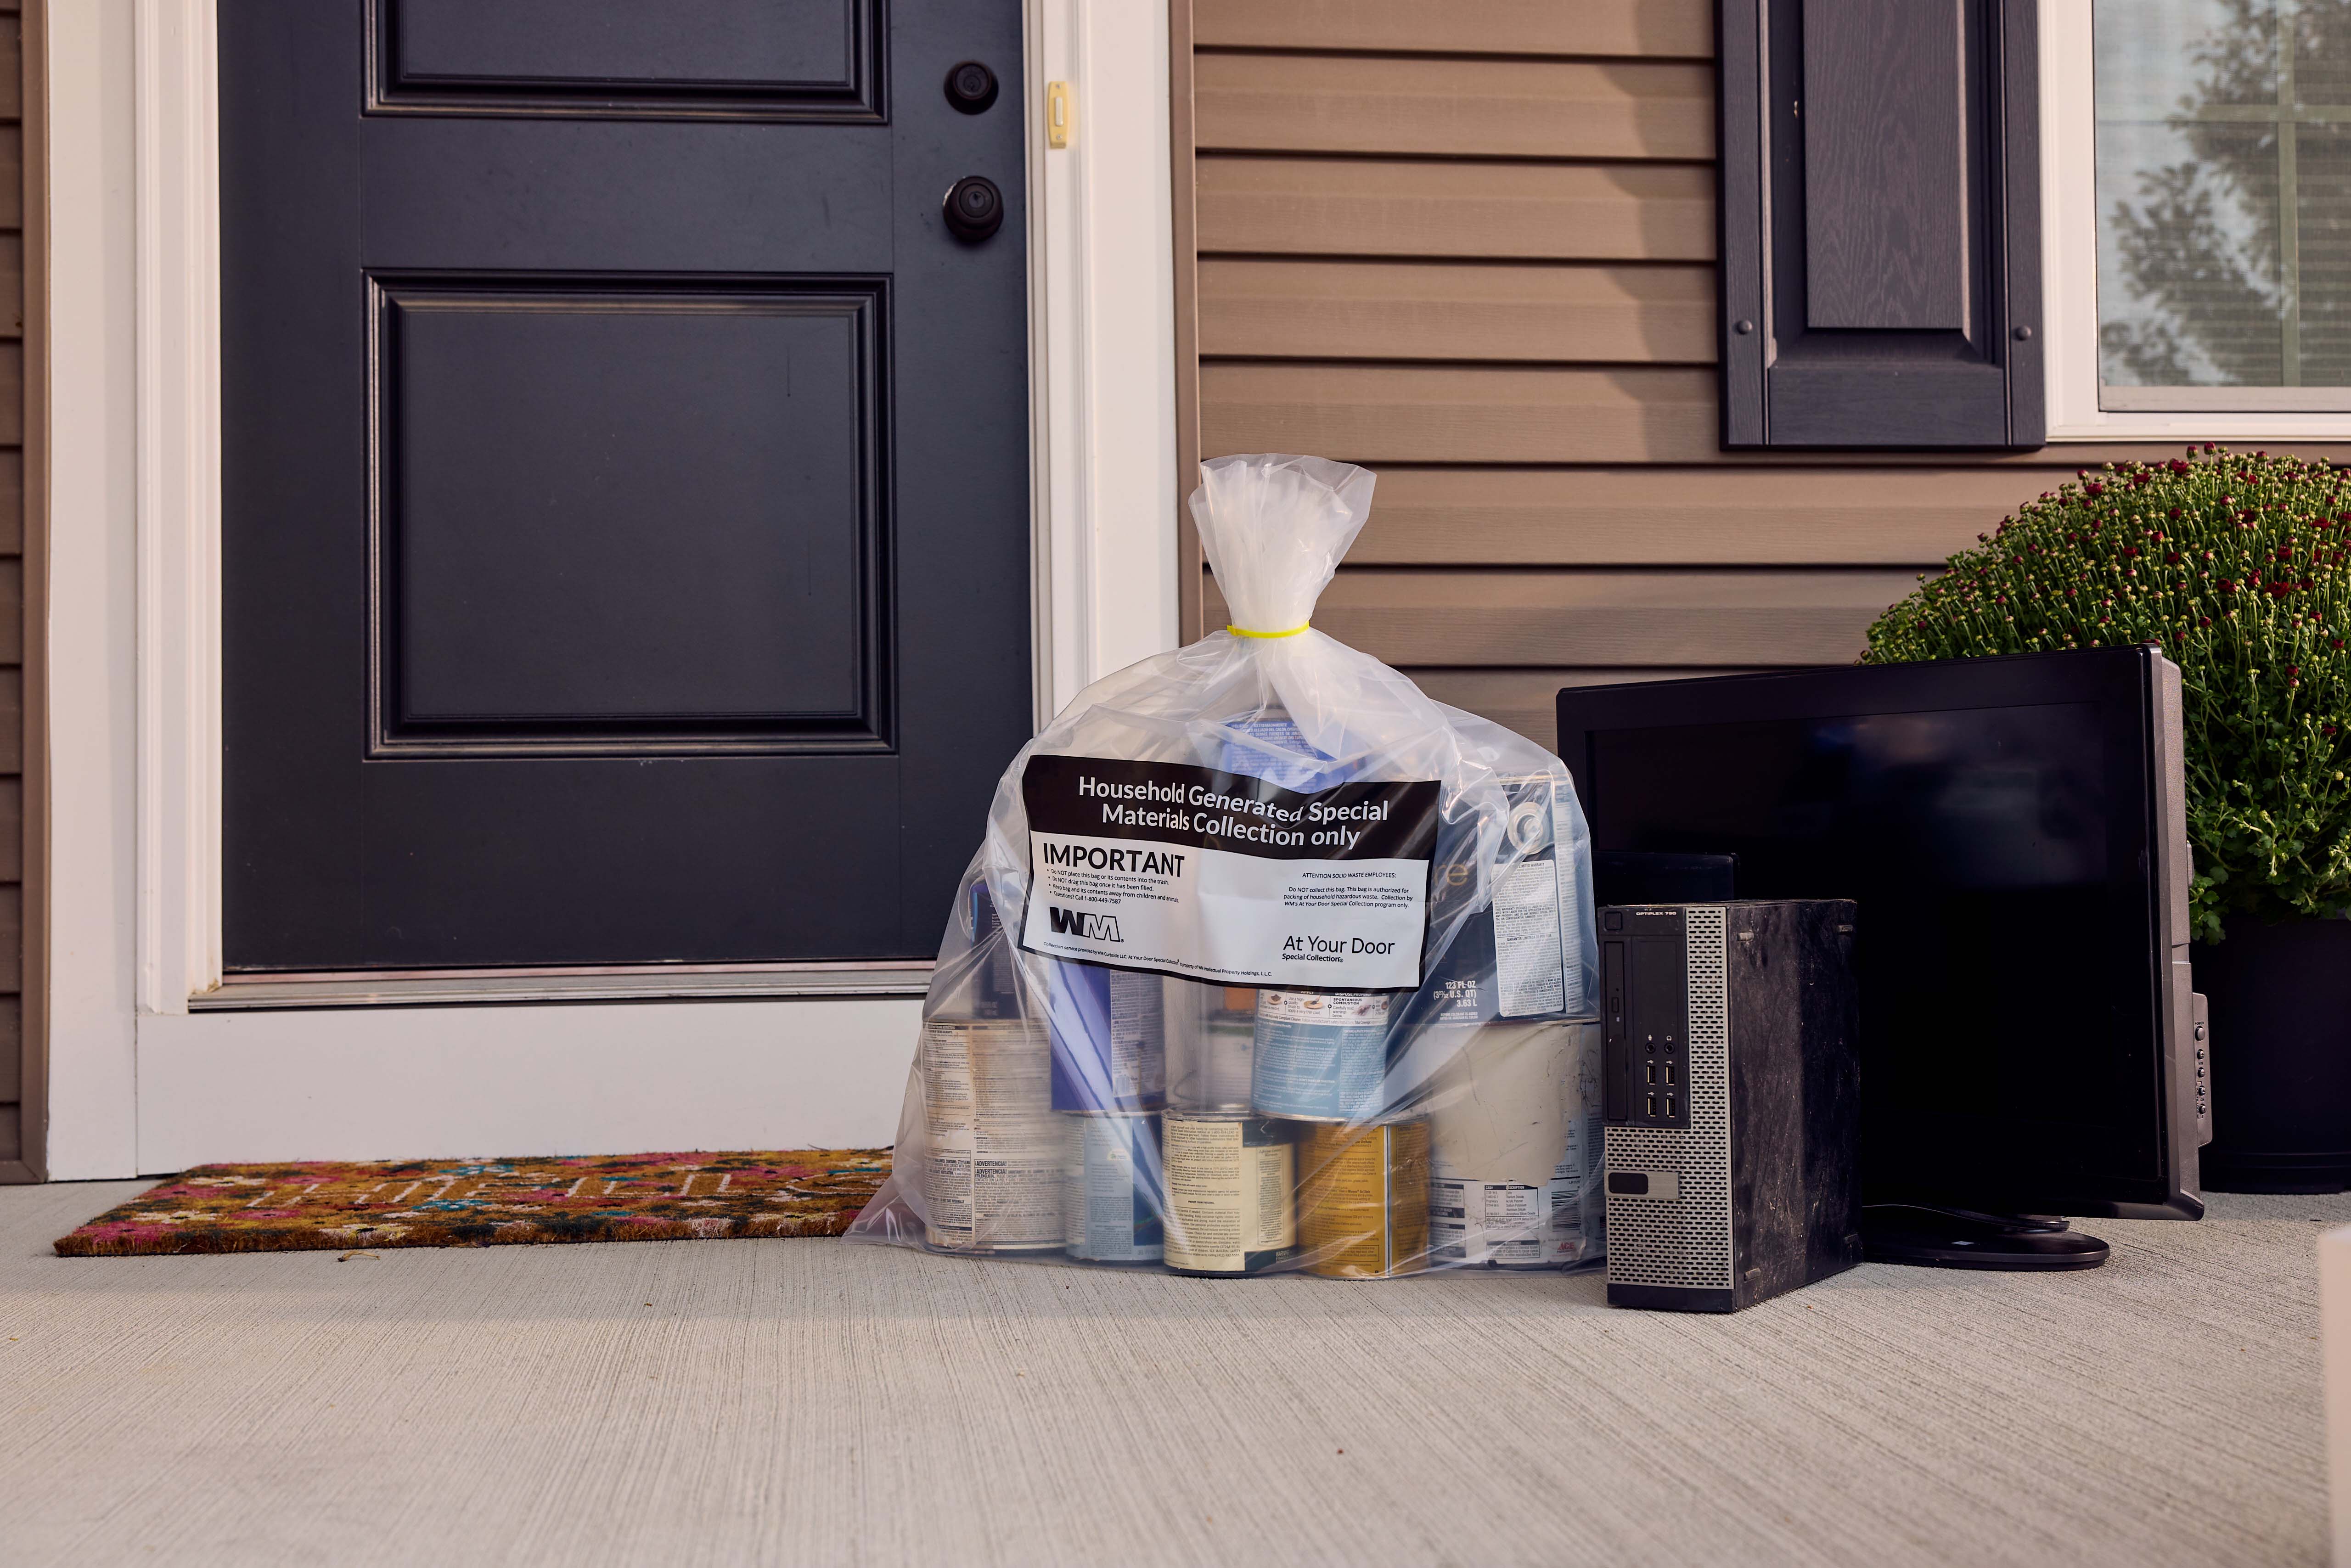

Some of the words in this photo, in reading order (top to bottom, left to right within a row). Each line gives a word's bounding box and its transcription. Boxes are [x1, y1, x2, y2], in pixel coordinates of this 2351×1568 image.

[1080, 776, 1184, 804] Household
[1189, 786, 1303, 822] Generated
[1308, 801, 1388, 825] Special
[1103, 804, 1189, 830] Materials
[1194, 812, 1304, 845] Collection
[1311, 826, 1361, 849] only
[1044, 843, 1185, 877] IMPORTANT
[1283, 936, 1303, 950] At
[1308, 936, 1347, 953] Your
[1352, 938, 1395, 954] Door
[1465, 989, 1476, 998] QT)
